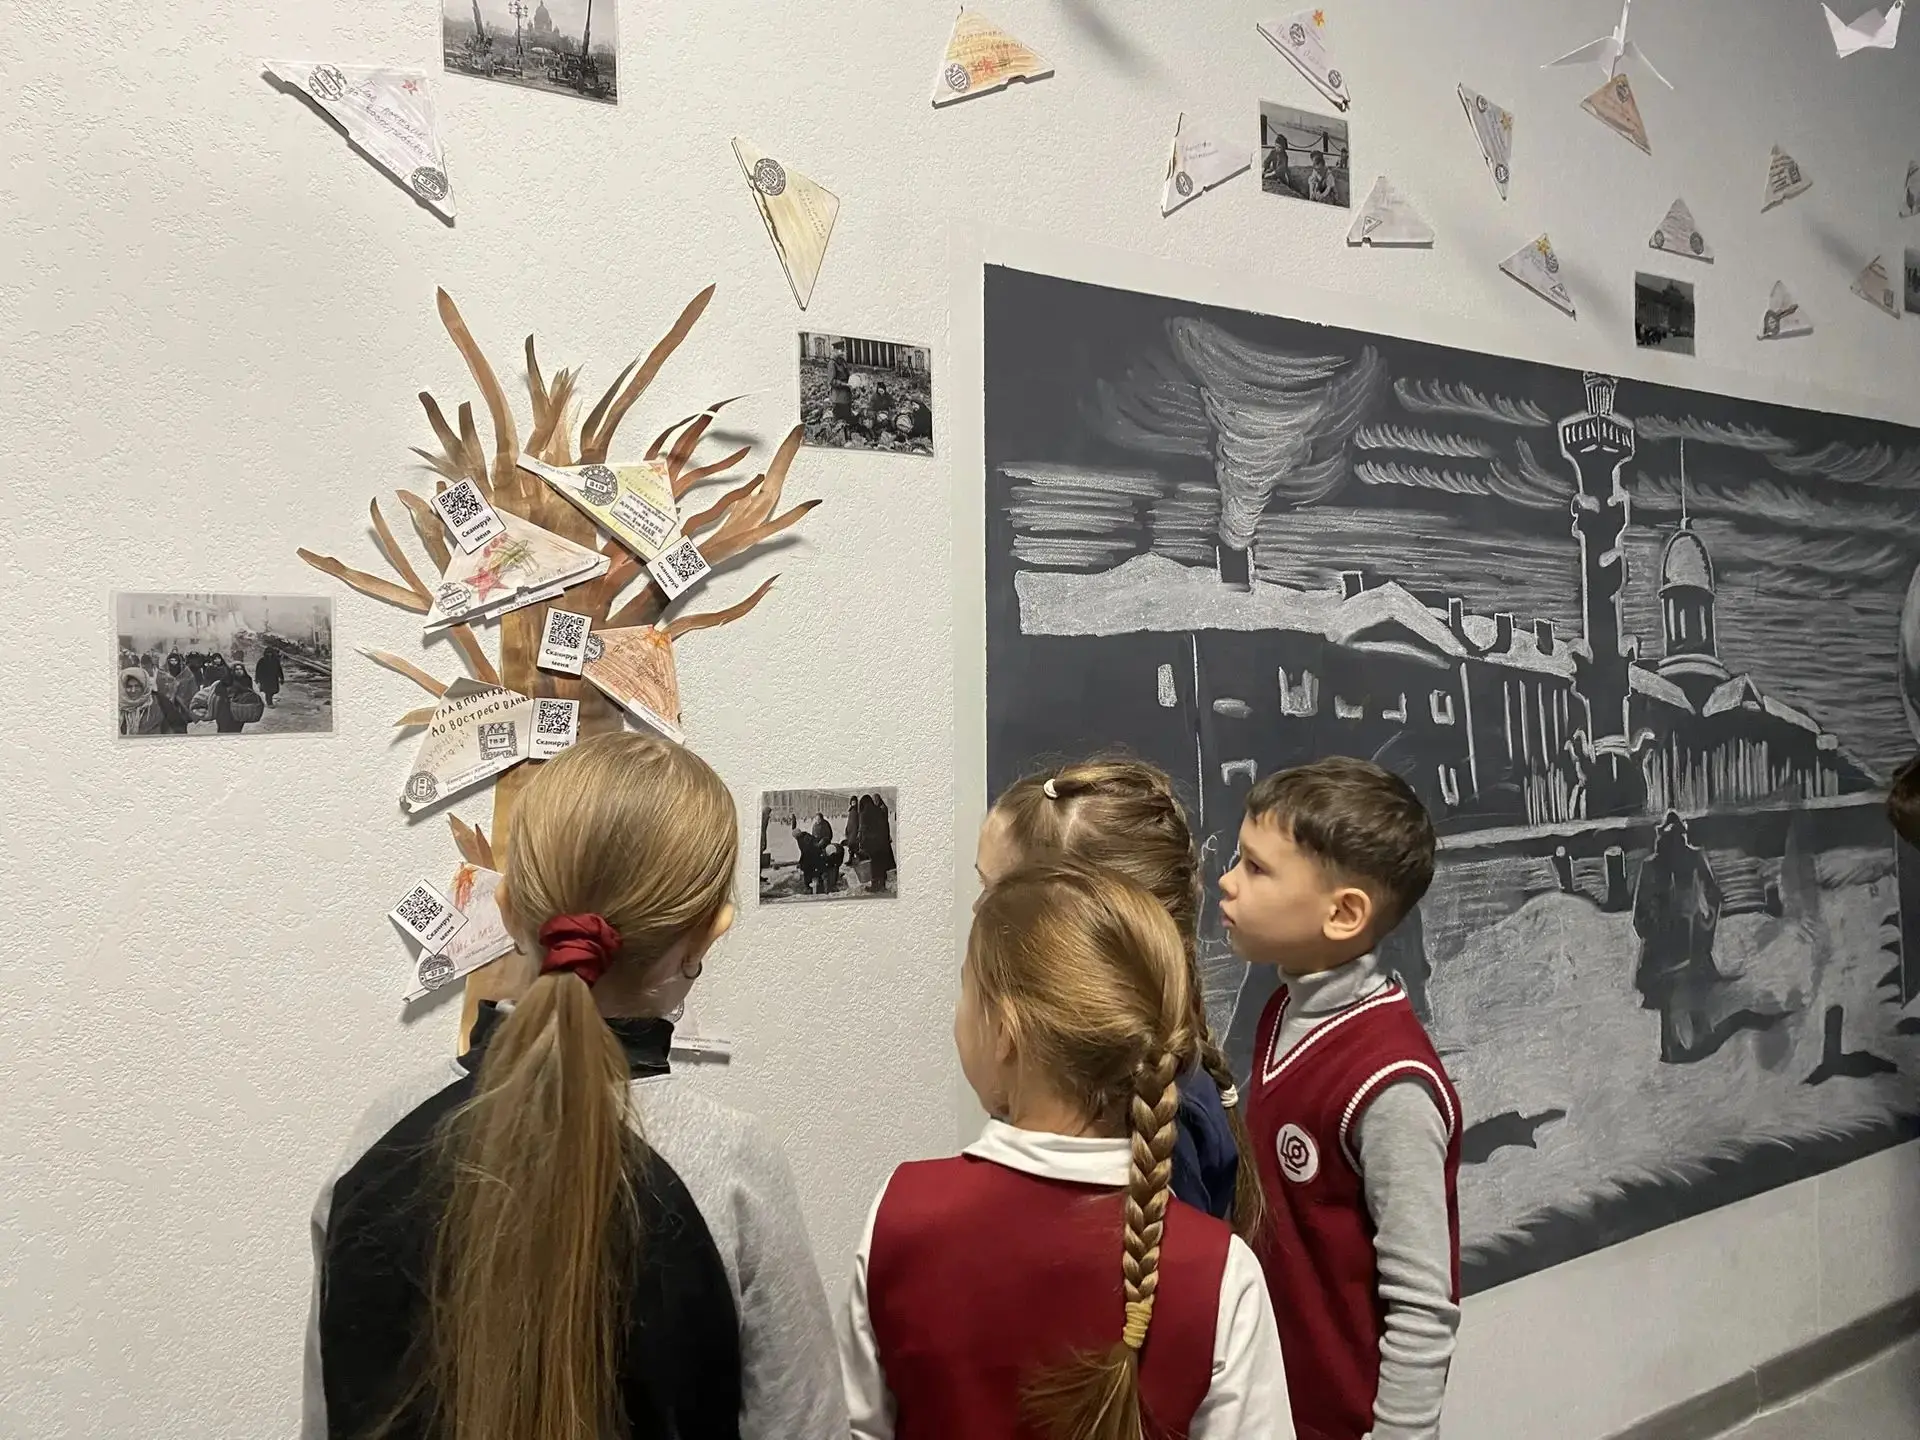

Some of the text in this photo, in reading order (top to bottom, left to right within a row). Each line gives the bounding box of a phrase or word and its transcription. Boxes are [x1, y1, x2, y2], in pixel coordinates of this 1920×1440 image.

[461, 516, 492, 538] Сканируй
[474, 529, 492, 542] меня
[656, 572, 668, 588] меня
[657, 561, 680, 589] Сканируй
[545, 648, 578, 661] Сканируй
[551, 660, 569, 668] меня
[536, 738, 570, 748] Сканируй
[426, 912, 454, 941] Сканируй
[439, 925, 455, 941] меня
